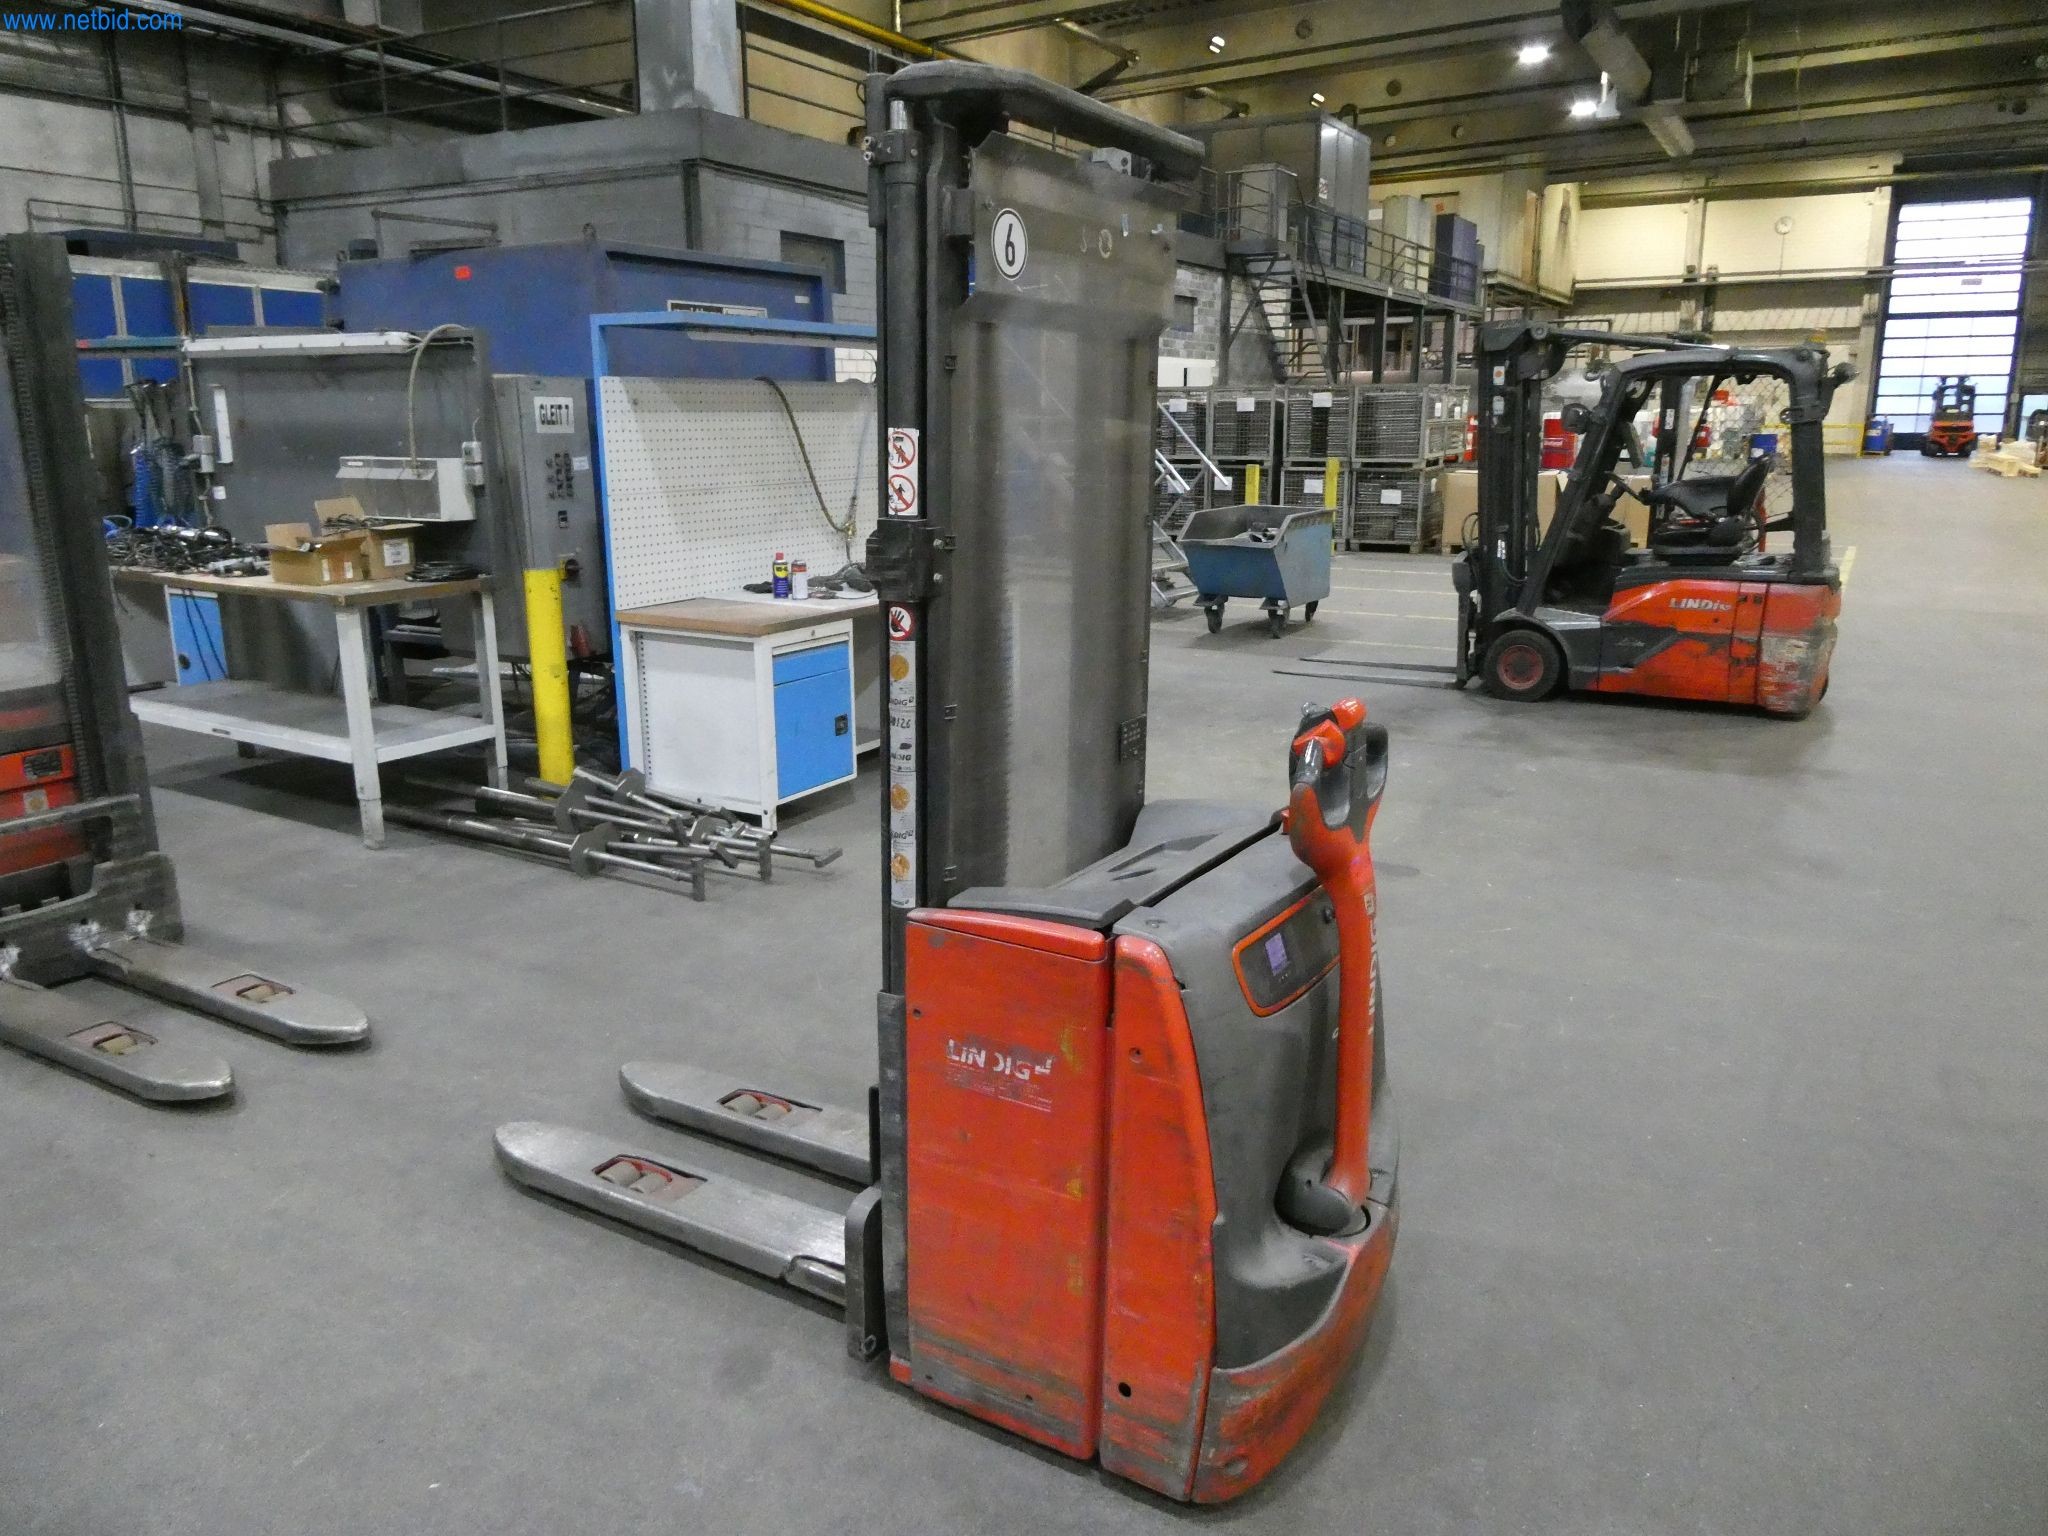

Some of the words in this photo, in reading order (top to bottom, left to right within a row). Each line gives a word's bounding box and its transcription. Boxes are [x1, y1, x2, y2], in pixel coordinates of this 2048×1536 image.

[1005, 223, 1015, 267] 6
[539, 404, 562, 426] GLEIT
[564, 404, 569, 426] 7
[946, 1039, 1032, 1081] LINDIG
